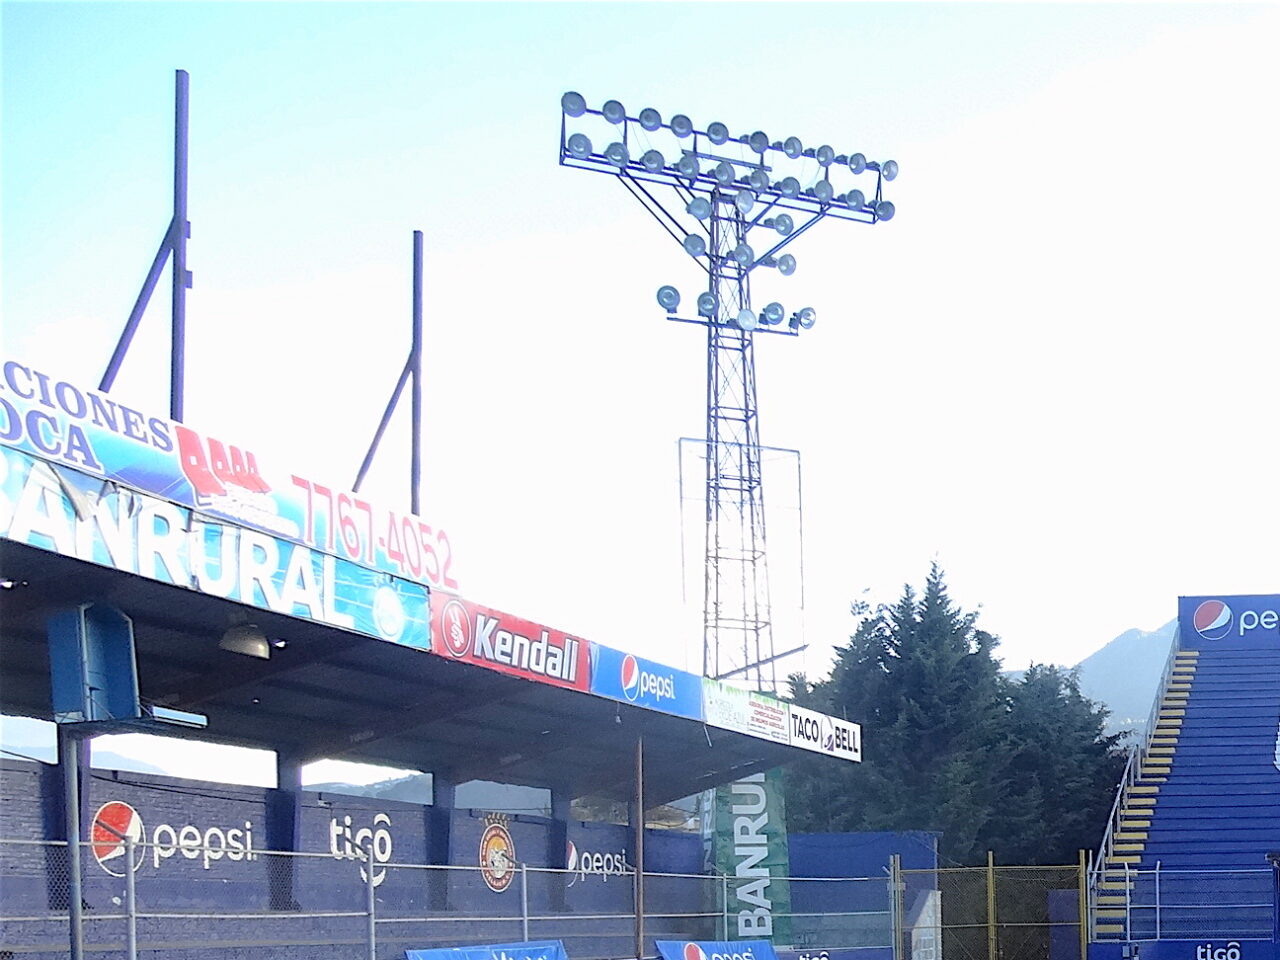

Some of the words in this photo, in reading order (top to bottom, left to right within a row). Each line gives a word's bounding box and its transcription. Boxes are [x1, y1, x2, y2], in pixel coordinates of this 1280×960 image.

[0, 361, 173, 452] CIONES
[0, 456, 355, 632] ANRURAL
[291, 474, 458, 590] 7767-4052
[472, 614, 580, 684] Kendall
[640, 670, 676, 701] pepsi
[791, 713, 820, 743] TACO
[835, 726, 859, 753] BELL
[153, 821, 253, 869] pepsi
[581, 849, 626, 882] pepsi
